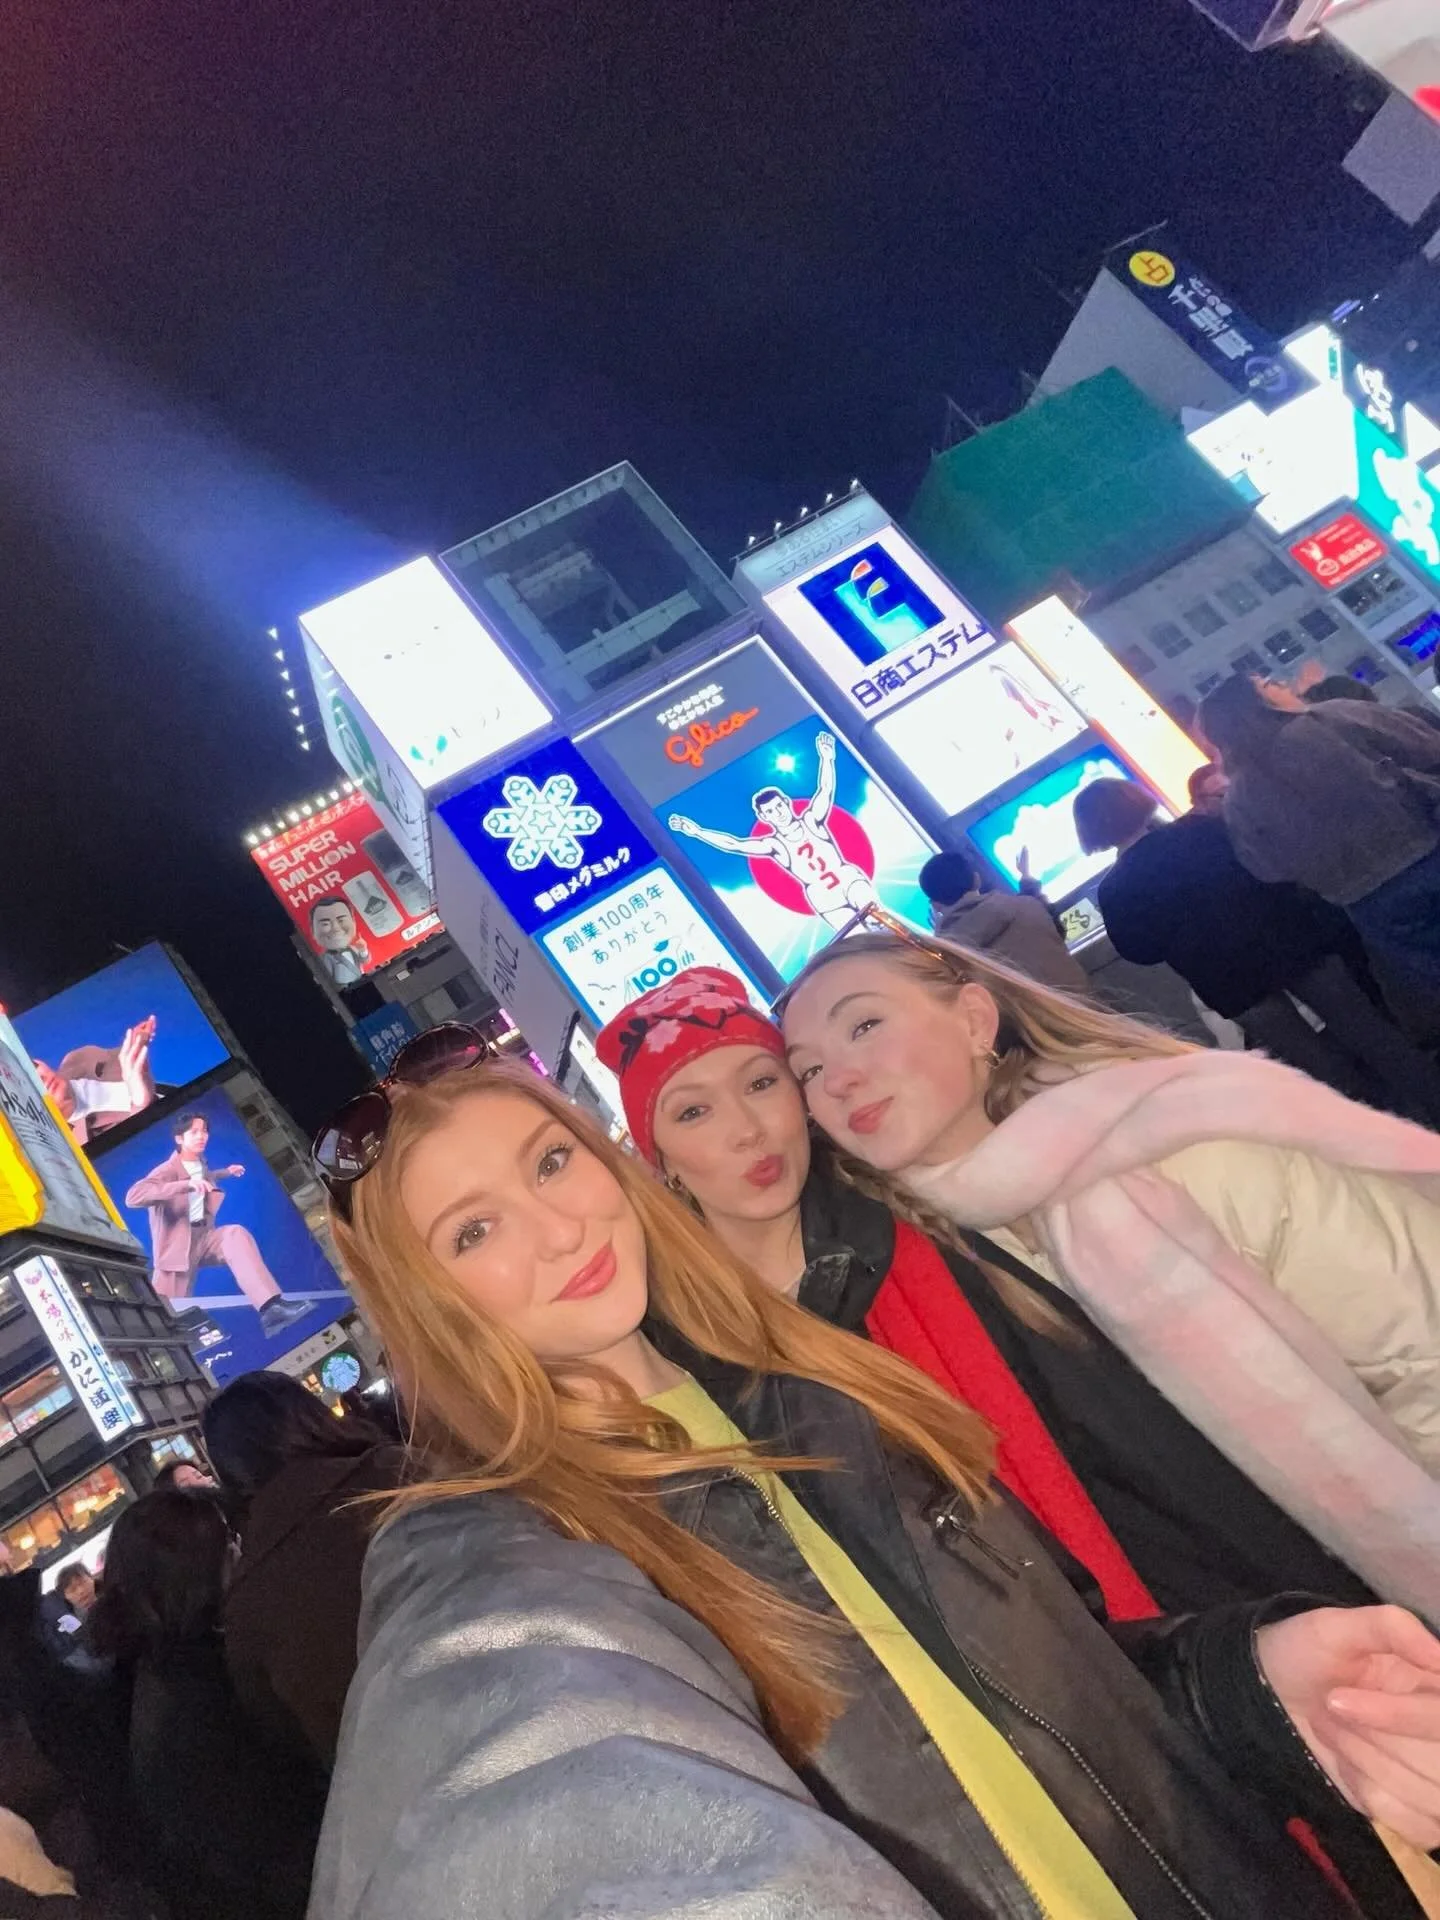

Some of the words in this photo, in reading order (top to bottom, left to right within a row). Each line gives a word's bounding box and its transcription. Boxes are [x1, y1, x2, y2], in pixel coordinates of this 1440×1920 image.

[850, 622, 989, 708] 日商エステム
[664, 707, 759, 768] Glico
[268, 829, 339, 876] SUPER
[278, 841, 357, 892] MILLION
[288, 870, 344, 908] HAIR
[562, 883, 664, 953] 創業100周年
[591, 911, 667, 964] ありがとう
